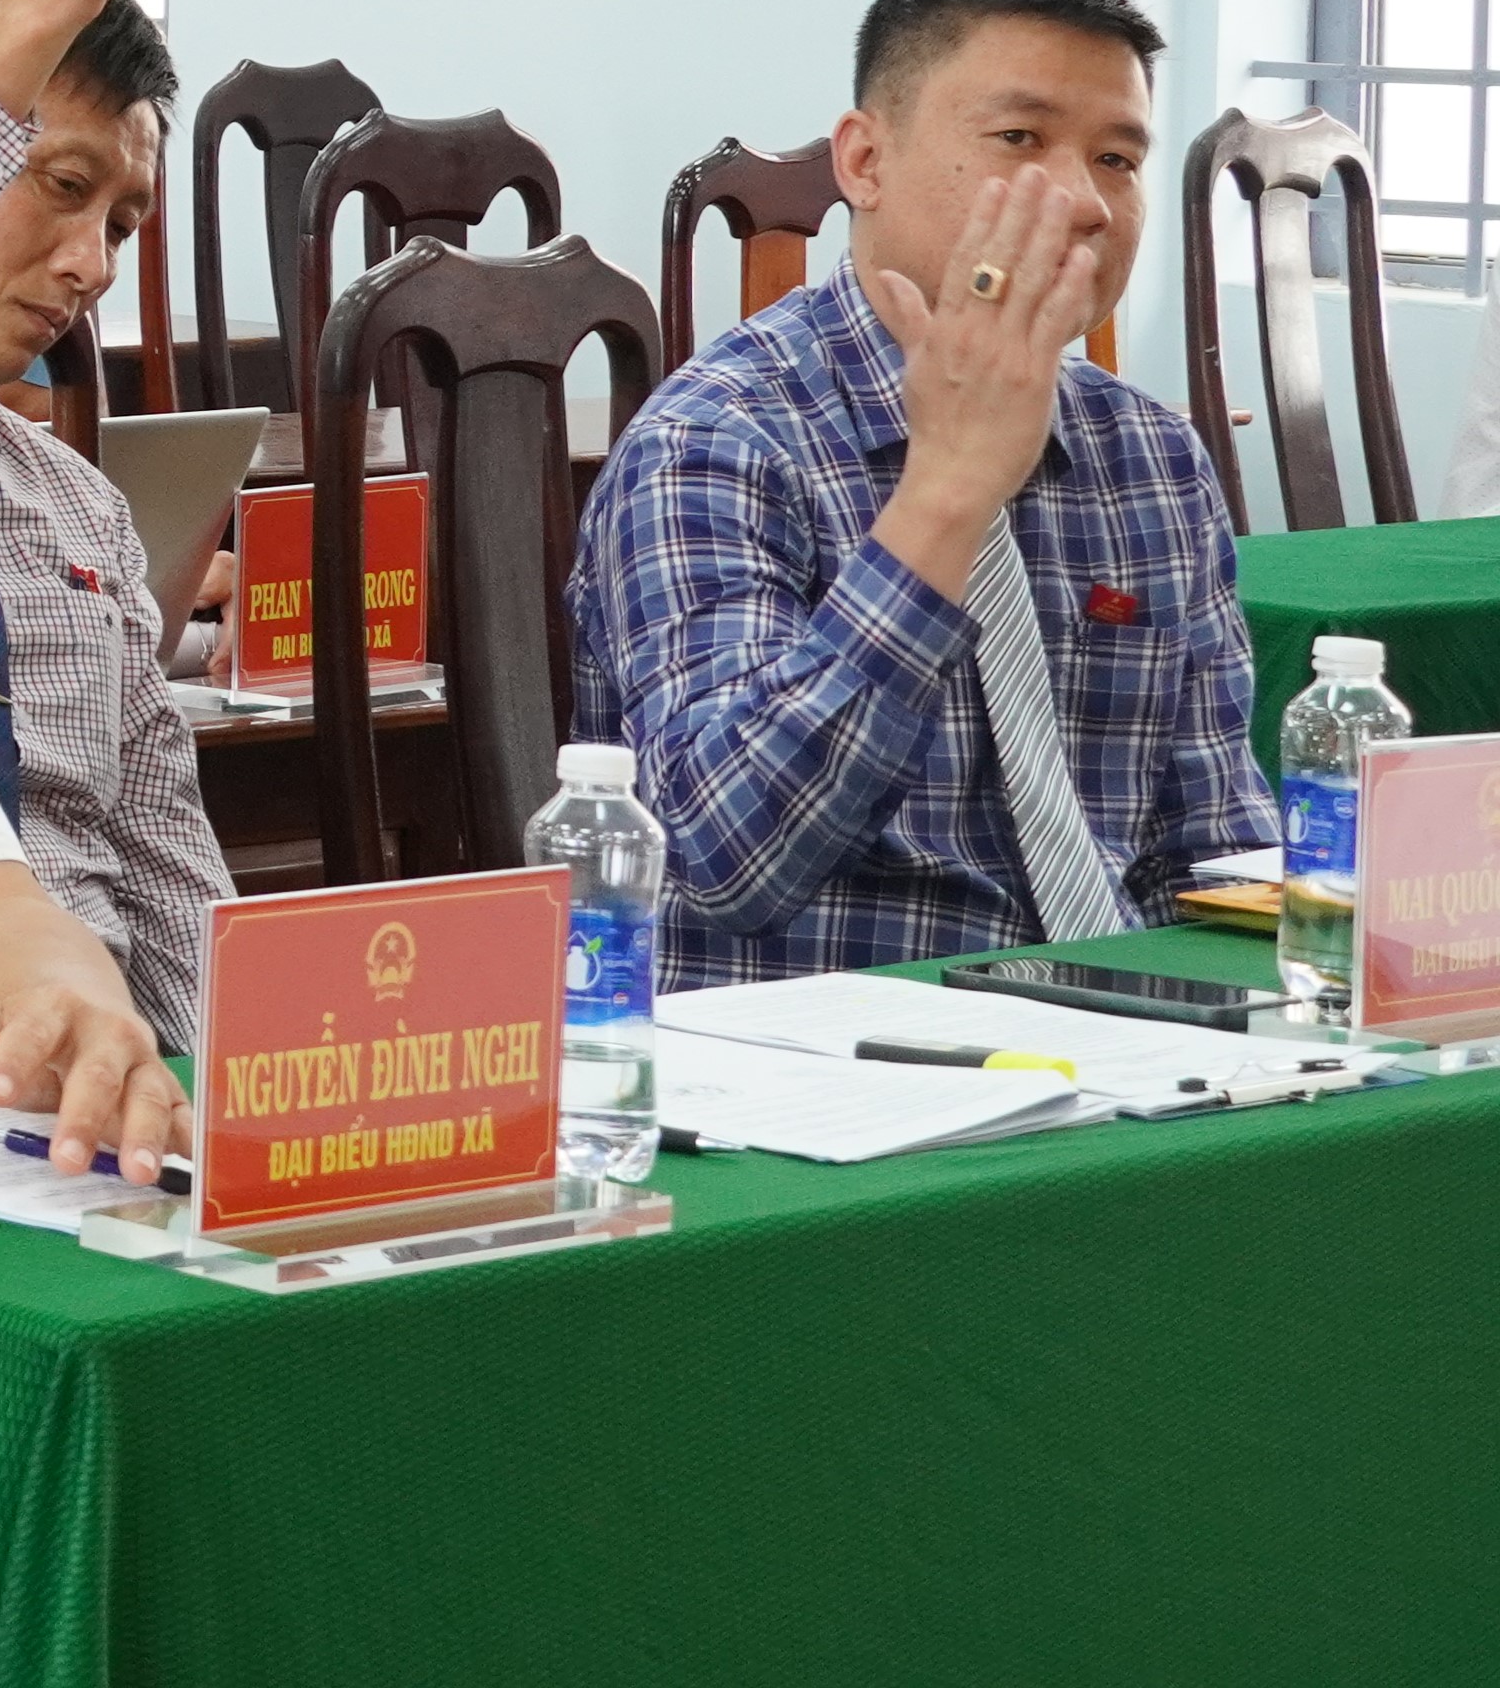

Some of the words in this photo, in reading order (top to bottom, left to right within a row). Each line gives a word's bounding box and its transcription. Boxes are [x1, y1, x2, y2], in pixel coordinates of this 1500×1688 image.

[249, 580, 302, 622] PHAN
[364, 568, 416, 610] RONG
[272, 634, 296, 664] ĐẠI
[373, 619, 392, 648] XÃ
[1388, 874, 1435, 923] MAI
[1442, 853, 1500, 927] QUỐ
[1411, 945, 1443, 984] ĐẠI
[1448, 930, 1490, 972] BIỂU
[224, 1011, 362, 1119] NGUYỄN
[369, 1018, 454, 1100] ĐÌNH
[460, 1020, 542, 1096] NGHỊ
[268, 1137, 314, 1187] ĐẠI
[320, 1113, 379, 1175] BIỂU
[385, 1118, 454, 1165] HĐND
[460, 1106, 495, 1155] XÃ
